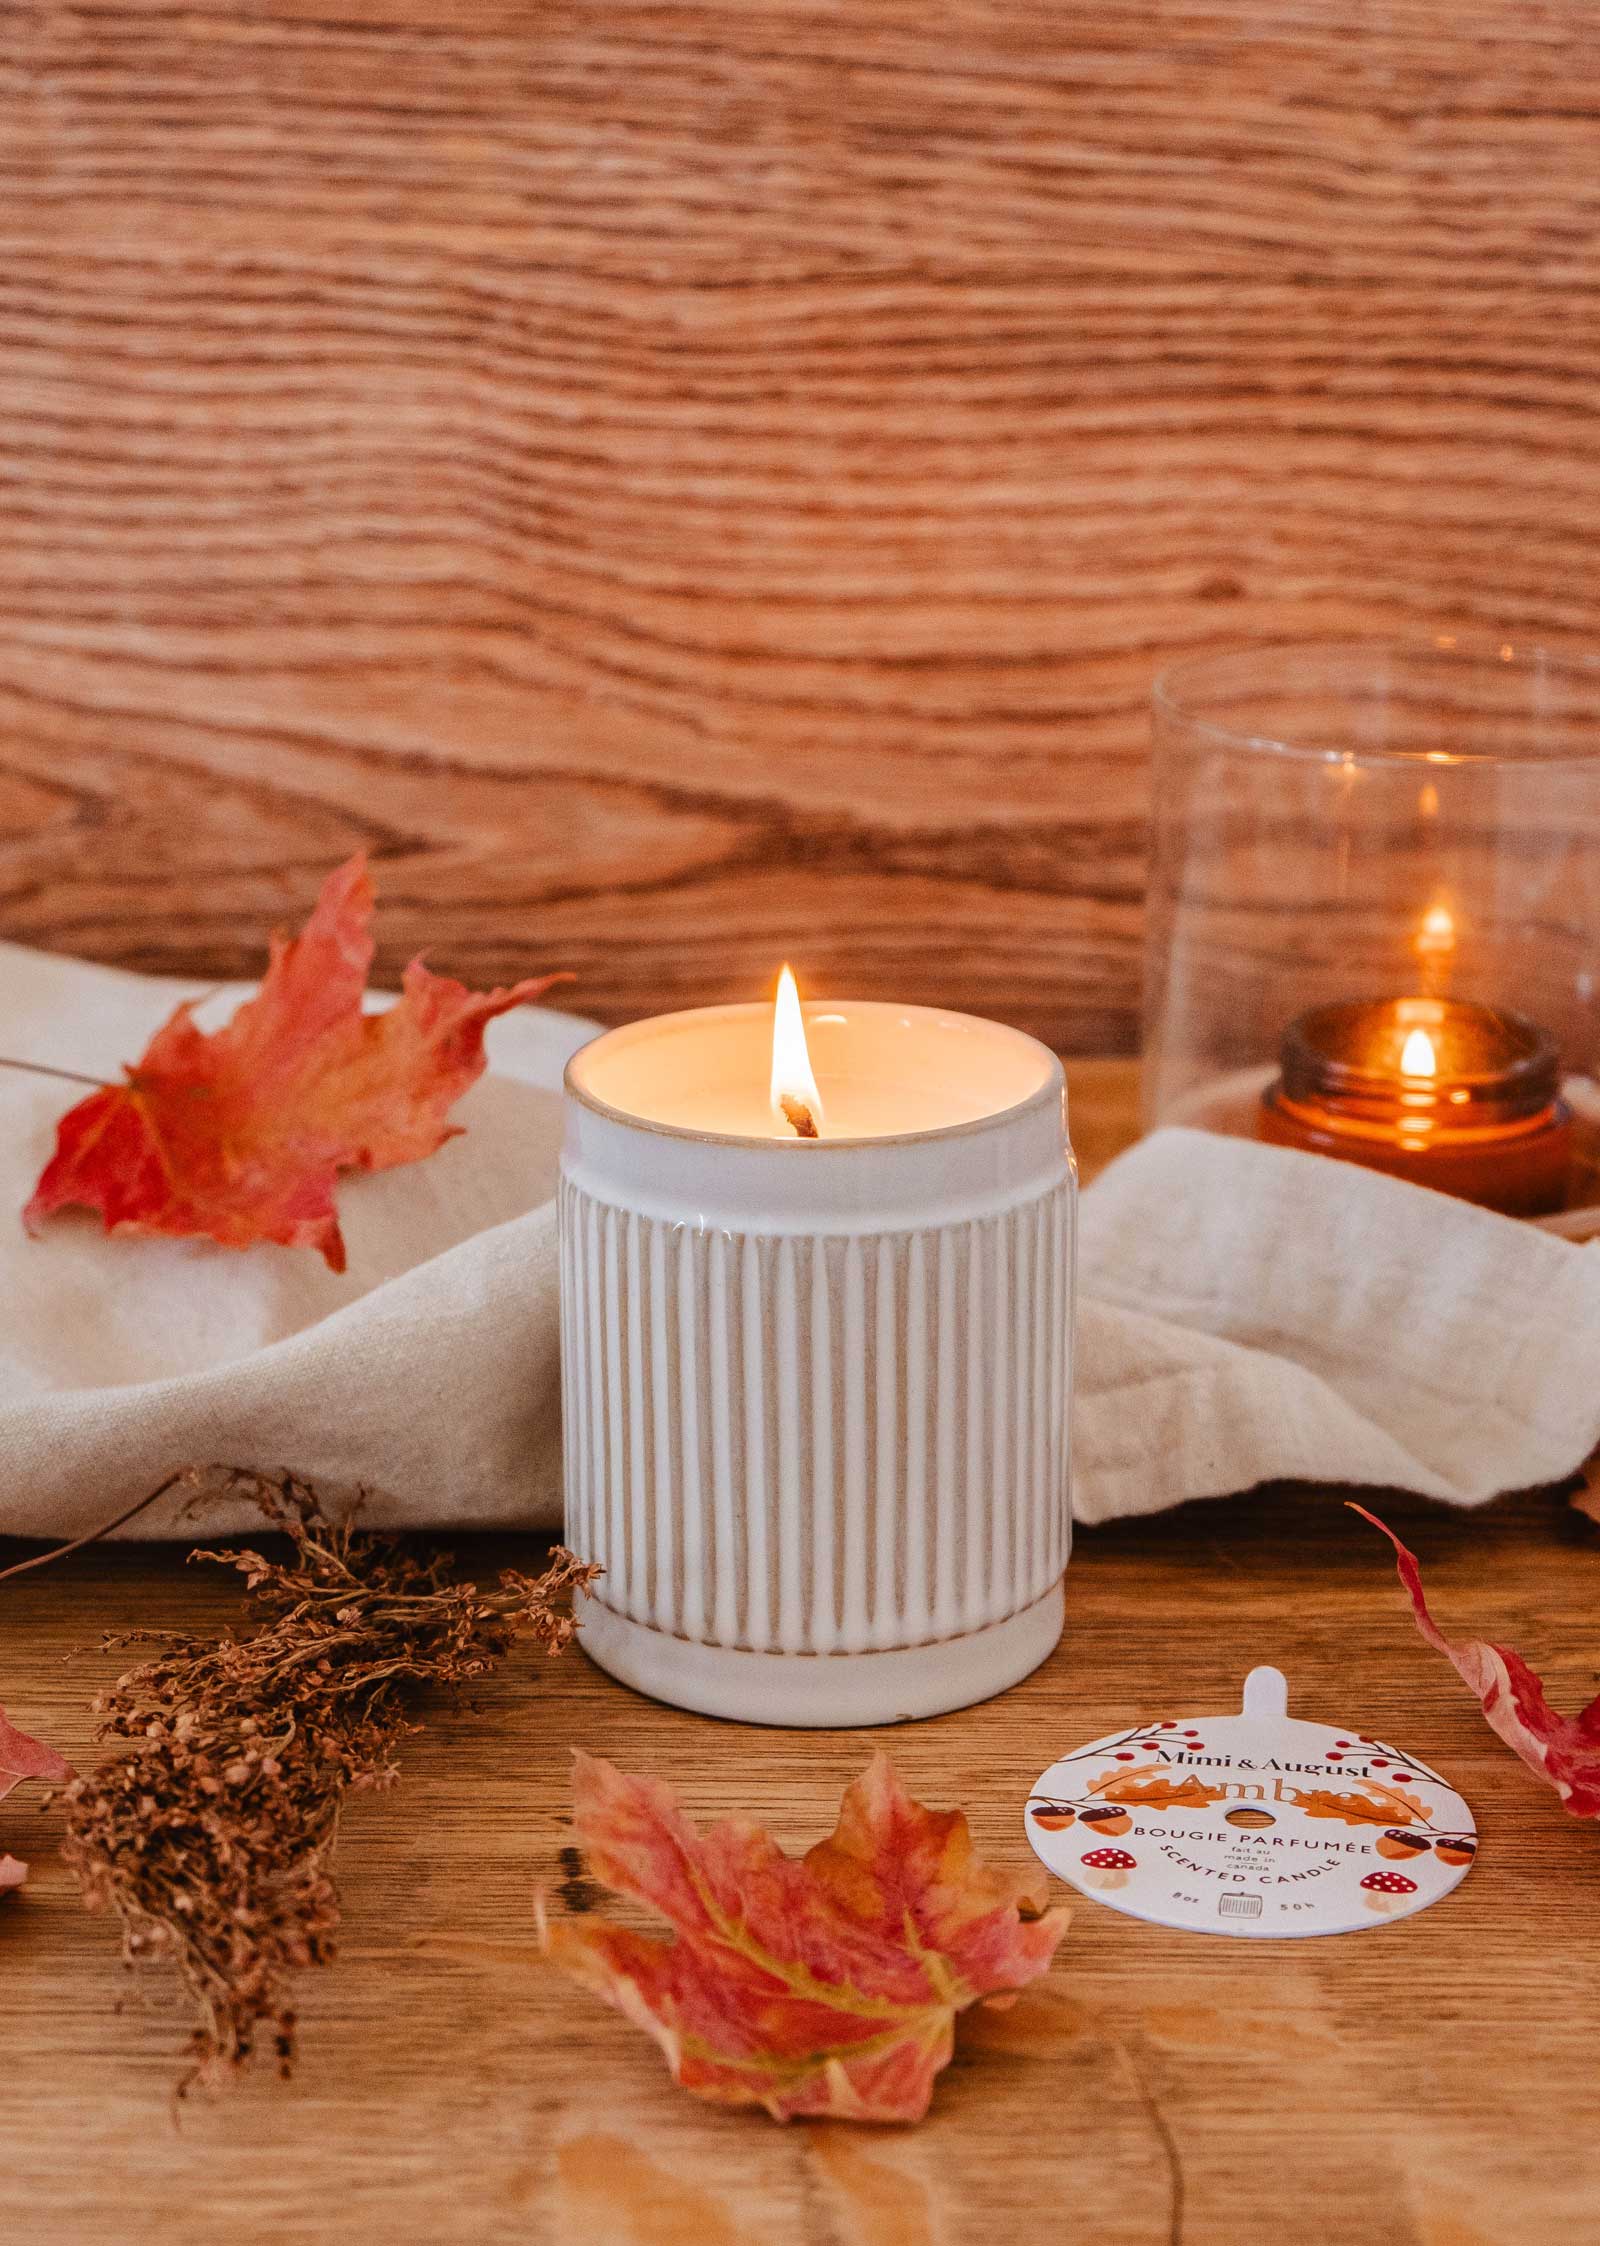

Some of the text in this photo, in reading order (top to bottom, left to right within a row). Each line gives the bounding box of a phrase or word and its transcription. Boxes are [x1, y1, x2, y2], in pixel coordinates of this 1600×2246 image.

[1155, 1750, 1231, 1768] Mimi
[1262, 1758, 1373, 1778] August
[1134, 1827, 1372, 1855] BOUGIE PARFUMÉE
[1160, 1844, 1341, 1884] SCENTED CANDLE
[1226, 1863, 1270, 1871] canada
